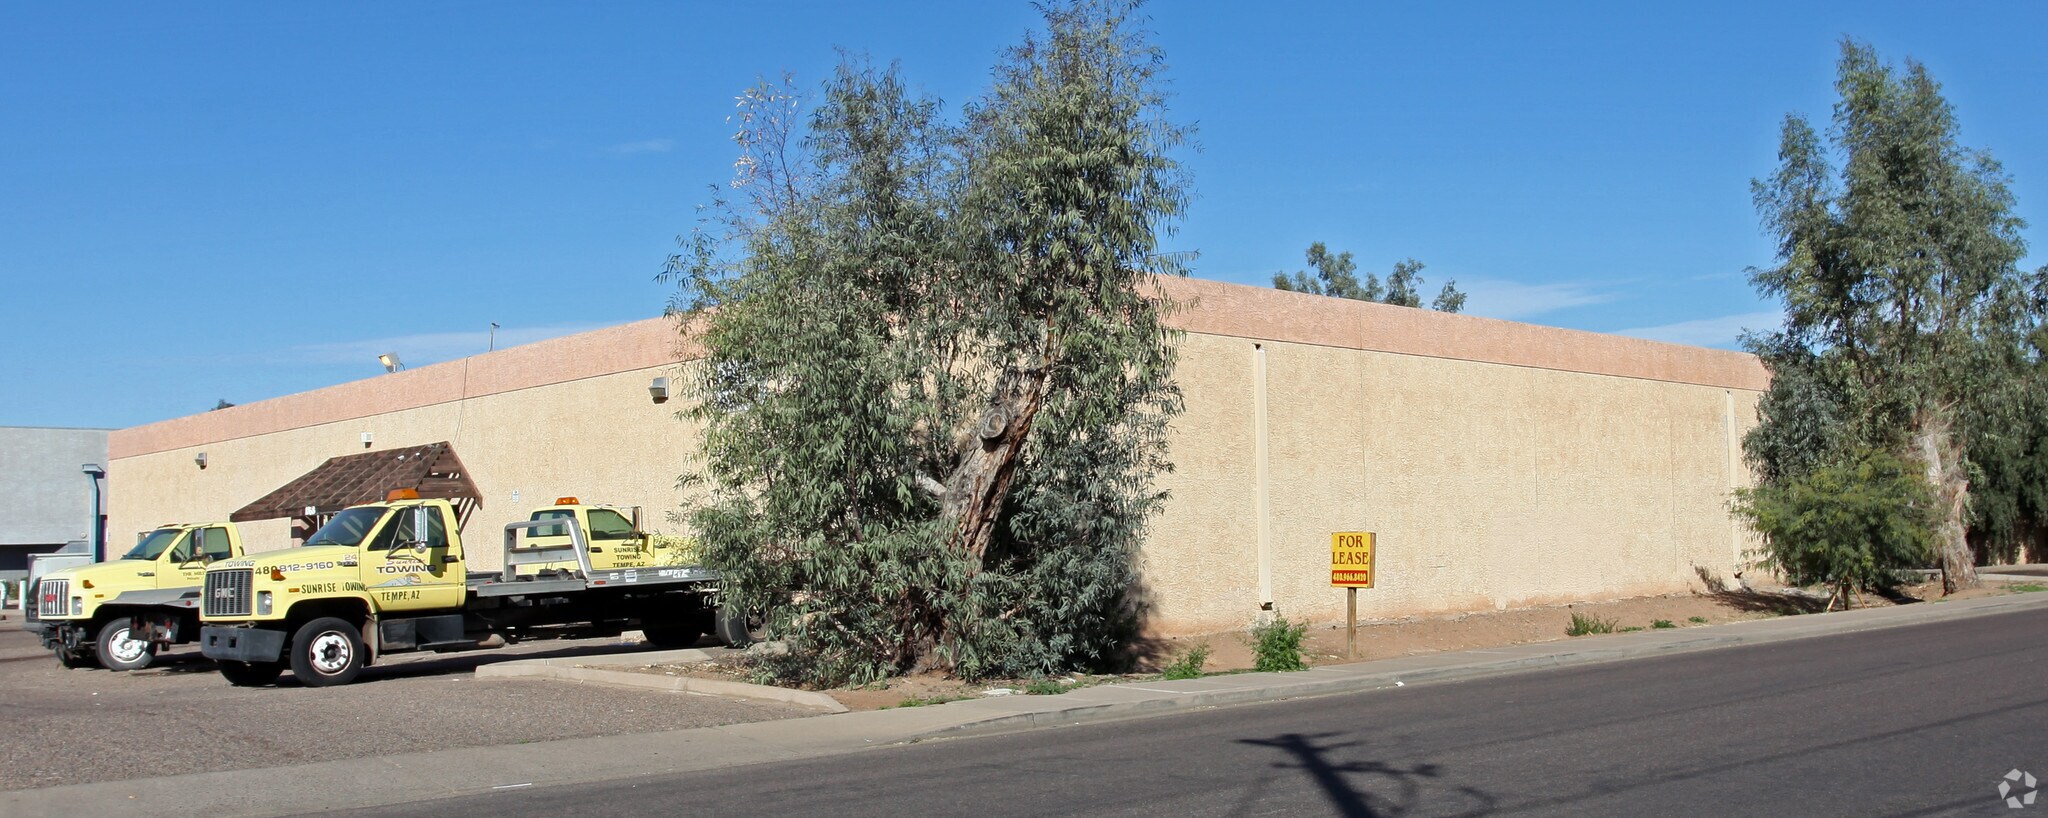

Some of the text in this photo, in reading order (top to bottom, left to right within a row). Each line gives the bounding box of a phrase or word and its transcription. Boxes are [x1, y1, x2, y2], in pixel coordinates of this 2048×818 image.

[1338, 535, 1363, 548] FOR
[1332, 551, 1369, 565] LEASE
[279, 561, 334, 572] 812-9160
[376, 564, 437, 574] TOWING
[215, 588, 235, 598] GMC
[301, 582, 337, 594] SUNRISE
[411, 590, 420, 600] AZ
